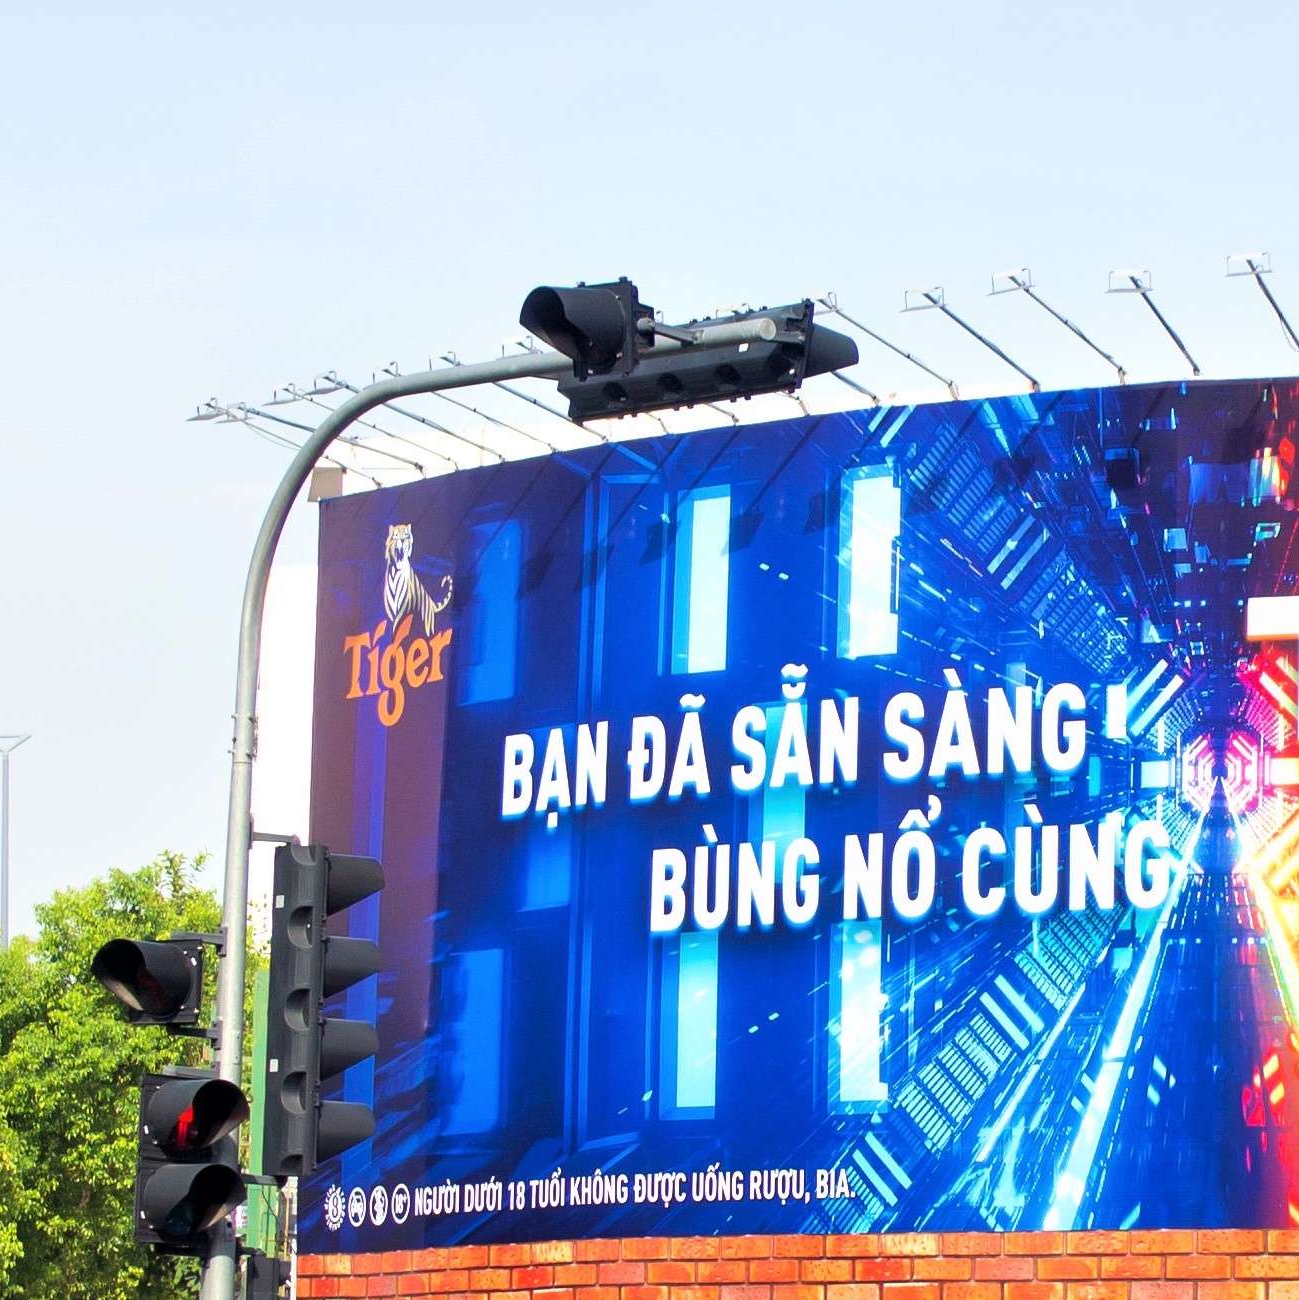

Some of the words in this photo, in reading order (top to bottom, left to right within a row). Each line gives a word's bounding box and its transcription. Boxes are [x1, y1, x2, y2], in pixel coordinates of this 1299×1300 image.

[343, 614, 453, 727] Tiger
[502, 720, 609, 828] BẠN
[627, 693, 712, 800] ĐÃ
[730, 663, 860, 791] SẴN
[882, 667, 1087, 780] SÀNG
[650, 824, 821, 933] BÙNG
[842, 793, 942, 920] NỔ
[962, 803, 1169, 916] CÙNG
[414, 1179, 460, 1216] NGƯỜI
[464, 1175, 502, 1212] DƯỚI
[507, 1181, 525, 1211] 18
[529, 1167, 566, 1209] TUỔI
[570, 1168, 628, 1205] KHÔNG
[633, 1171, 686, 1208] ĐƯỢC
[692, 1162, 743, 1201] UỐNG
[750, 1169, 811, 1205] RƯỢU,
[816, 1168, 856, 1200] BIA.
